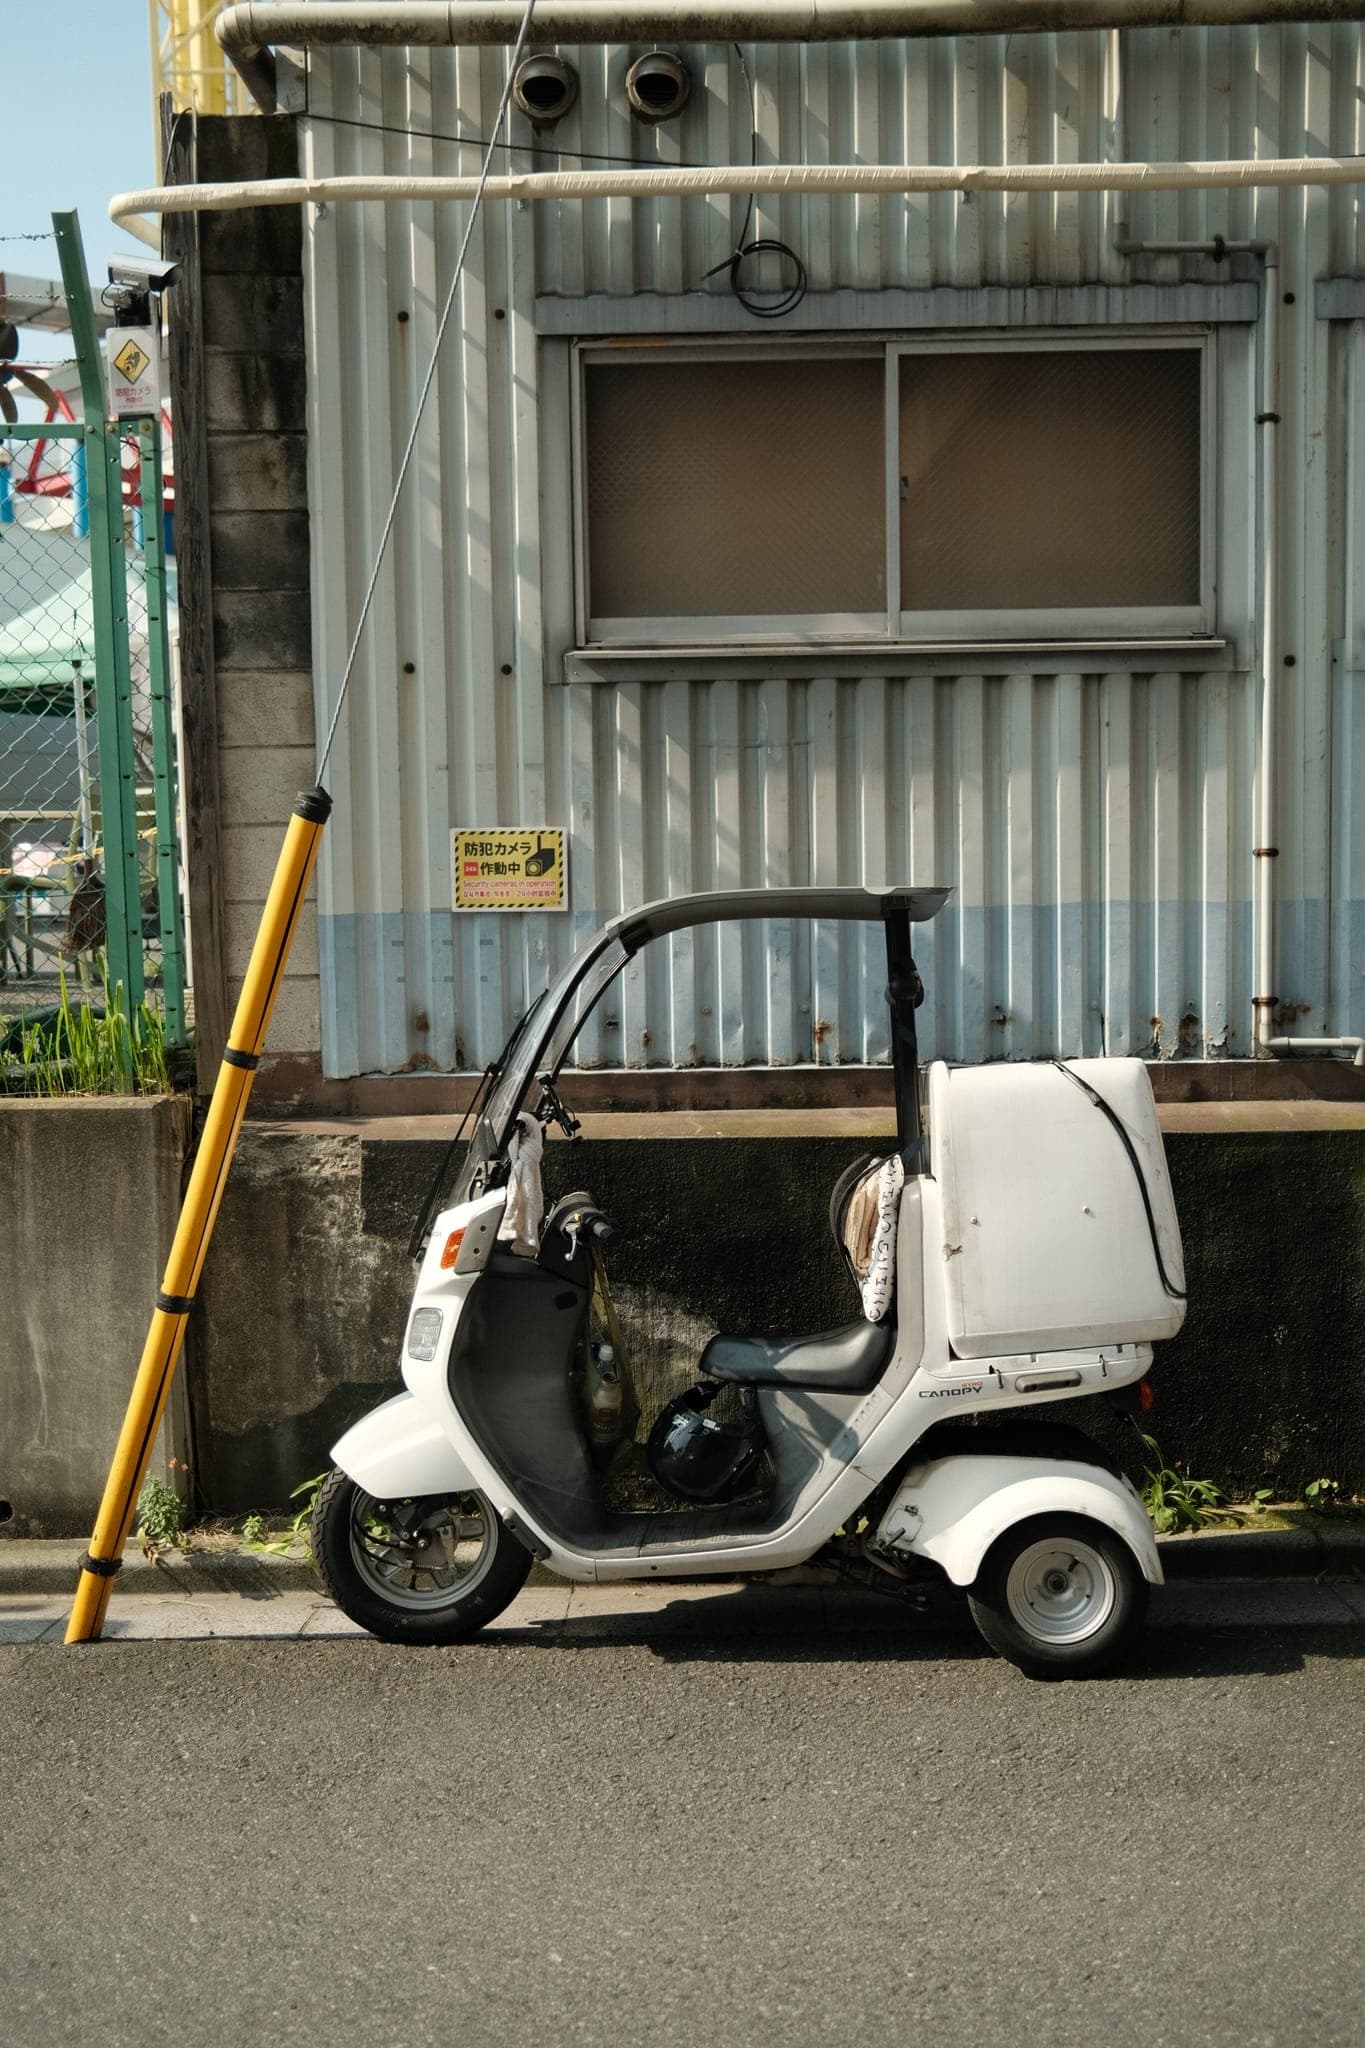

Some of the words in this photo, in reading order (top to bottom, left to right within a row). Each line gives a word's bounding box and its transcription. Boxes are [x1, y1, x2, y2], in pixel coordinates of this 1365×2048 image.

[464, 842, 532, 857] 防犯カメラ
[480, 862, 521, 876] 作動中
[463, 880, 488, 888] Security
[526, 880, 556, 888] operation
[919, 1387, 982, 1398] CANOPY
